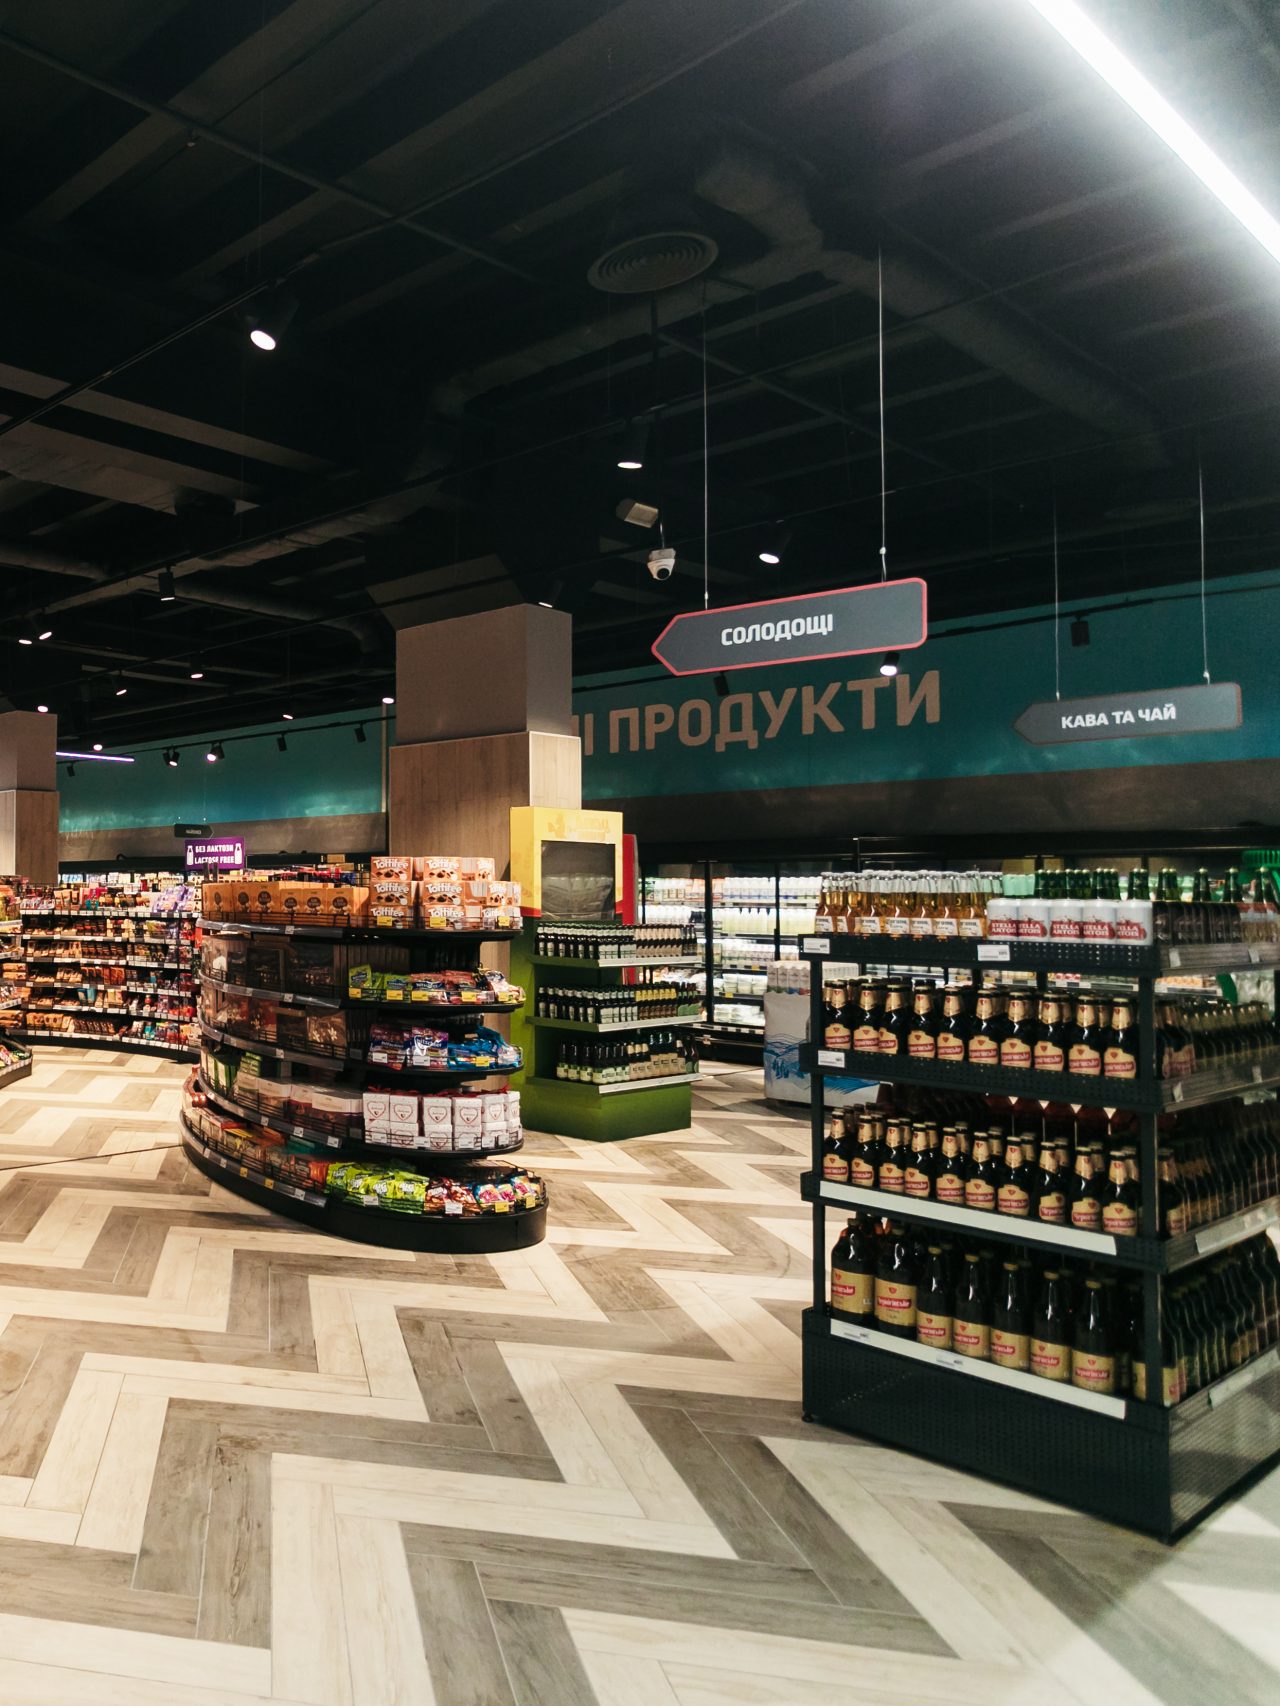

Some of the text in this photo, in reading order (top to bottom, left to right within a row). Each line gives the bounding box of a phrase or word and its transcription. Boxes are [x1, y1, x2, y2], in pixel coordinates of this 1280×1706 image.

[721, 613, 834, 646] СОЛОДОЩІ
[609, 671, 940, 754] ПРОДУКТИ
[1061, 703, 1176, 729] КАВА ТА ЧАЙ
[220, 855, 235, 864] FREE
[373, 858, 409, 870] Toffifee
[427, 858, 460, 870] Toffifee
[374, 883, 410, 894] Toffifee
[426, 883, 462, 894] Toffifee
